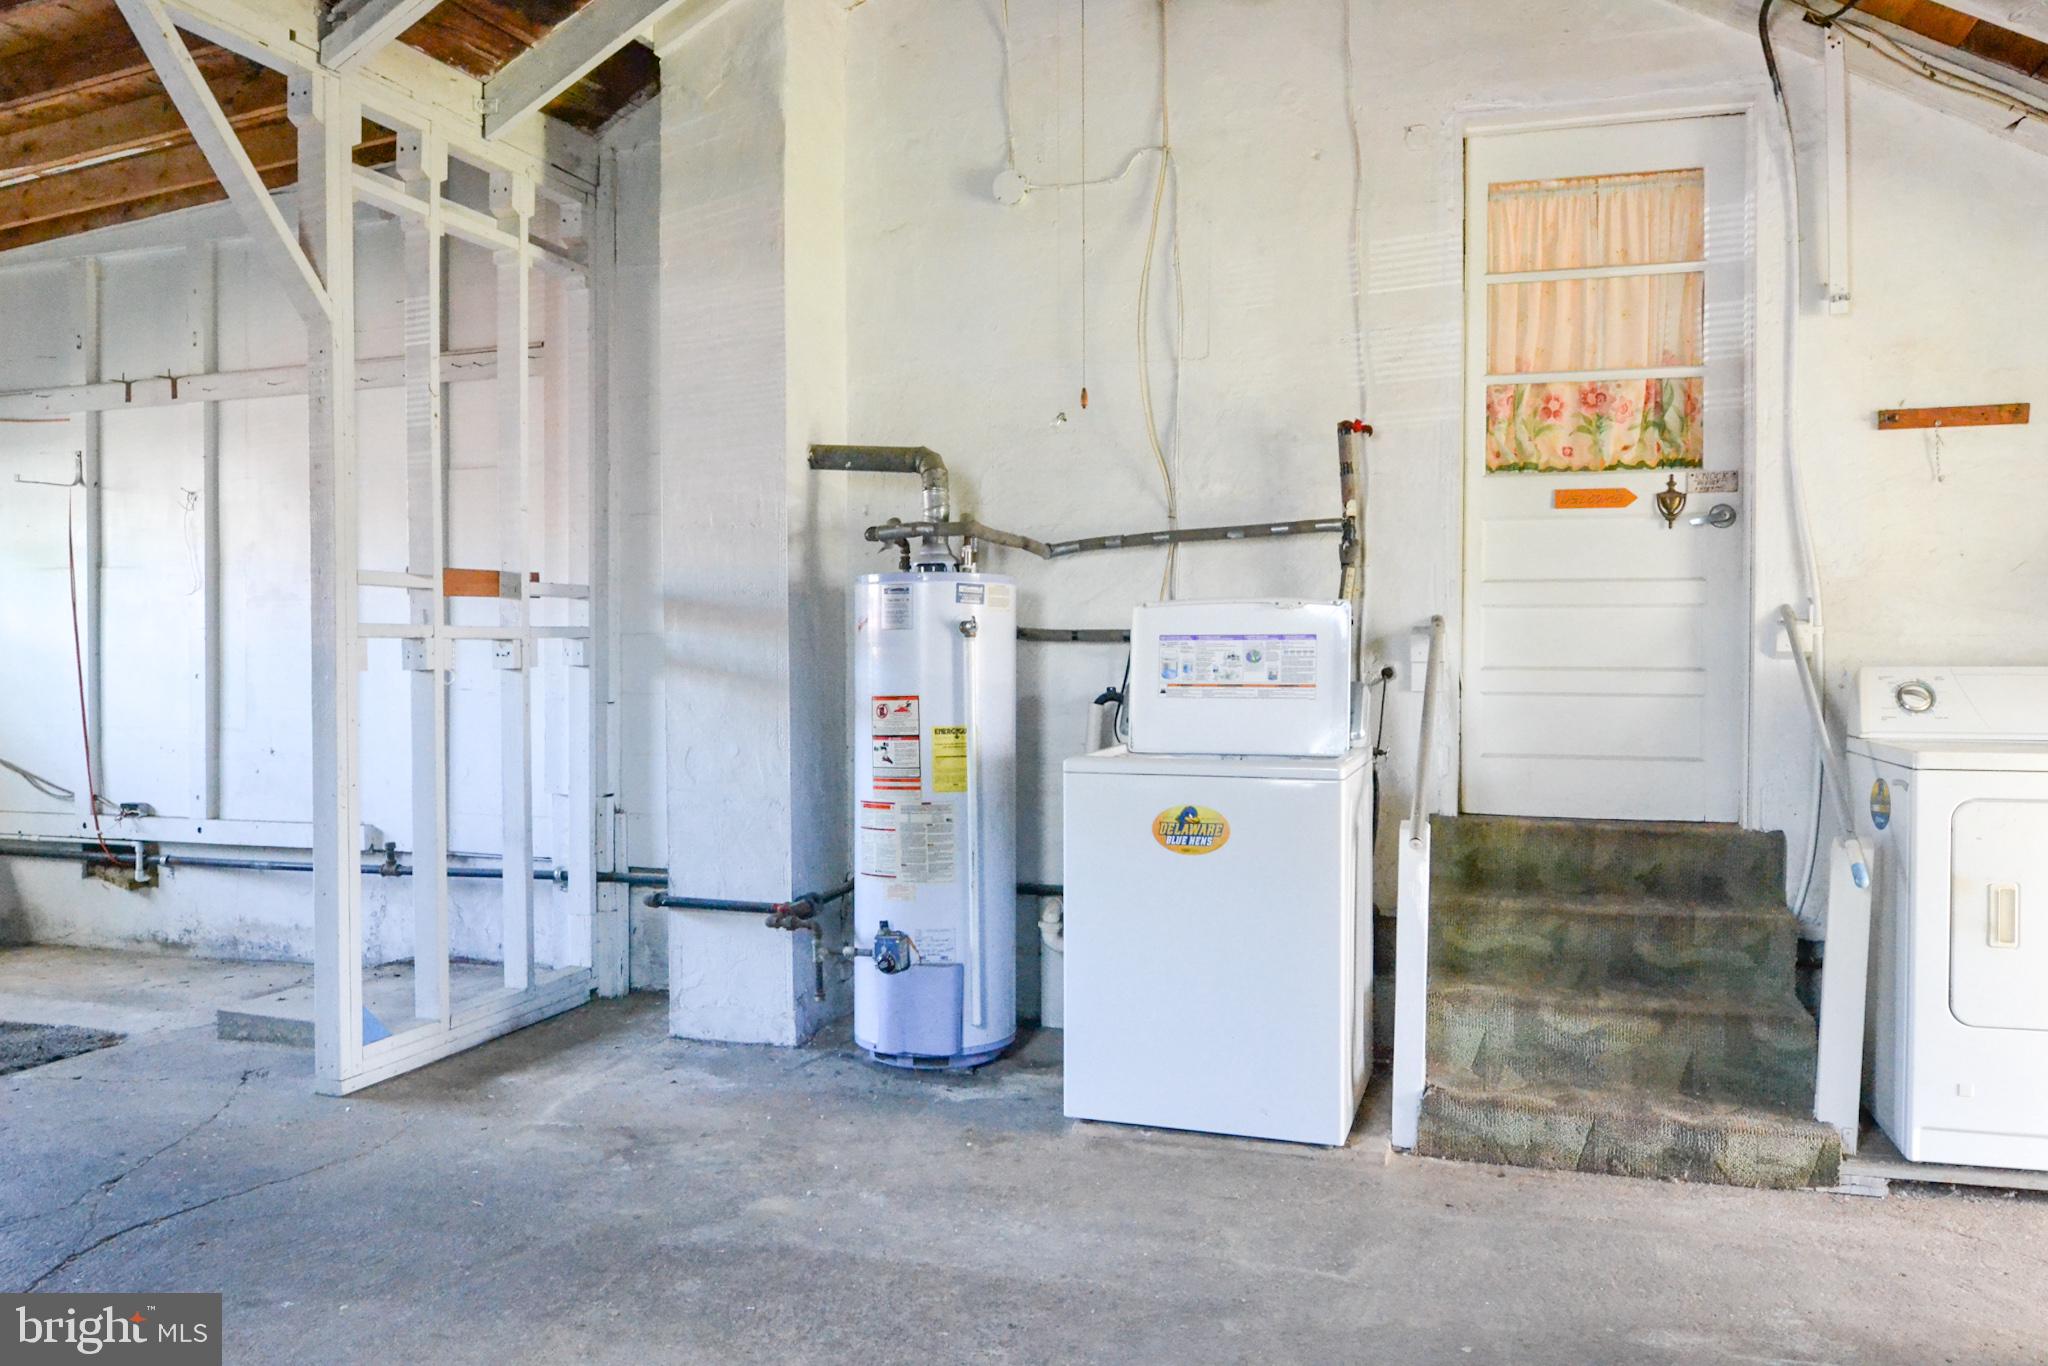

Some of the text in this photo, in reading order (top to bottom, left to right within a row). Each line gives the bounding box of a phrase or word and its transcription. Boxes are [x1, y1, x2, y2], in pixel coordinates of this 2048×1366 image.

[1159, 821, 1225, 837] DELAWARE
[1165, 835, 1213, 847] BLUE HENS
